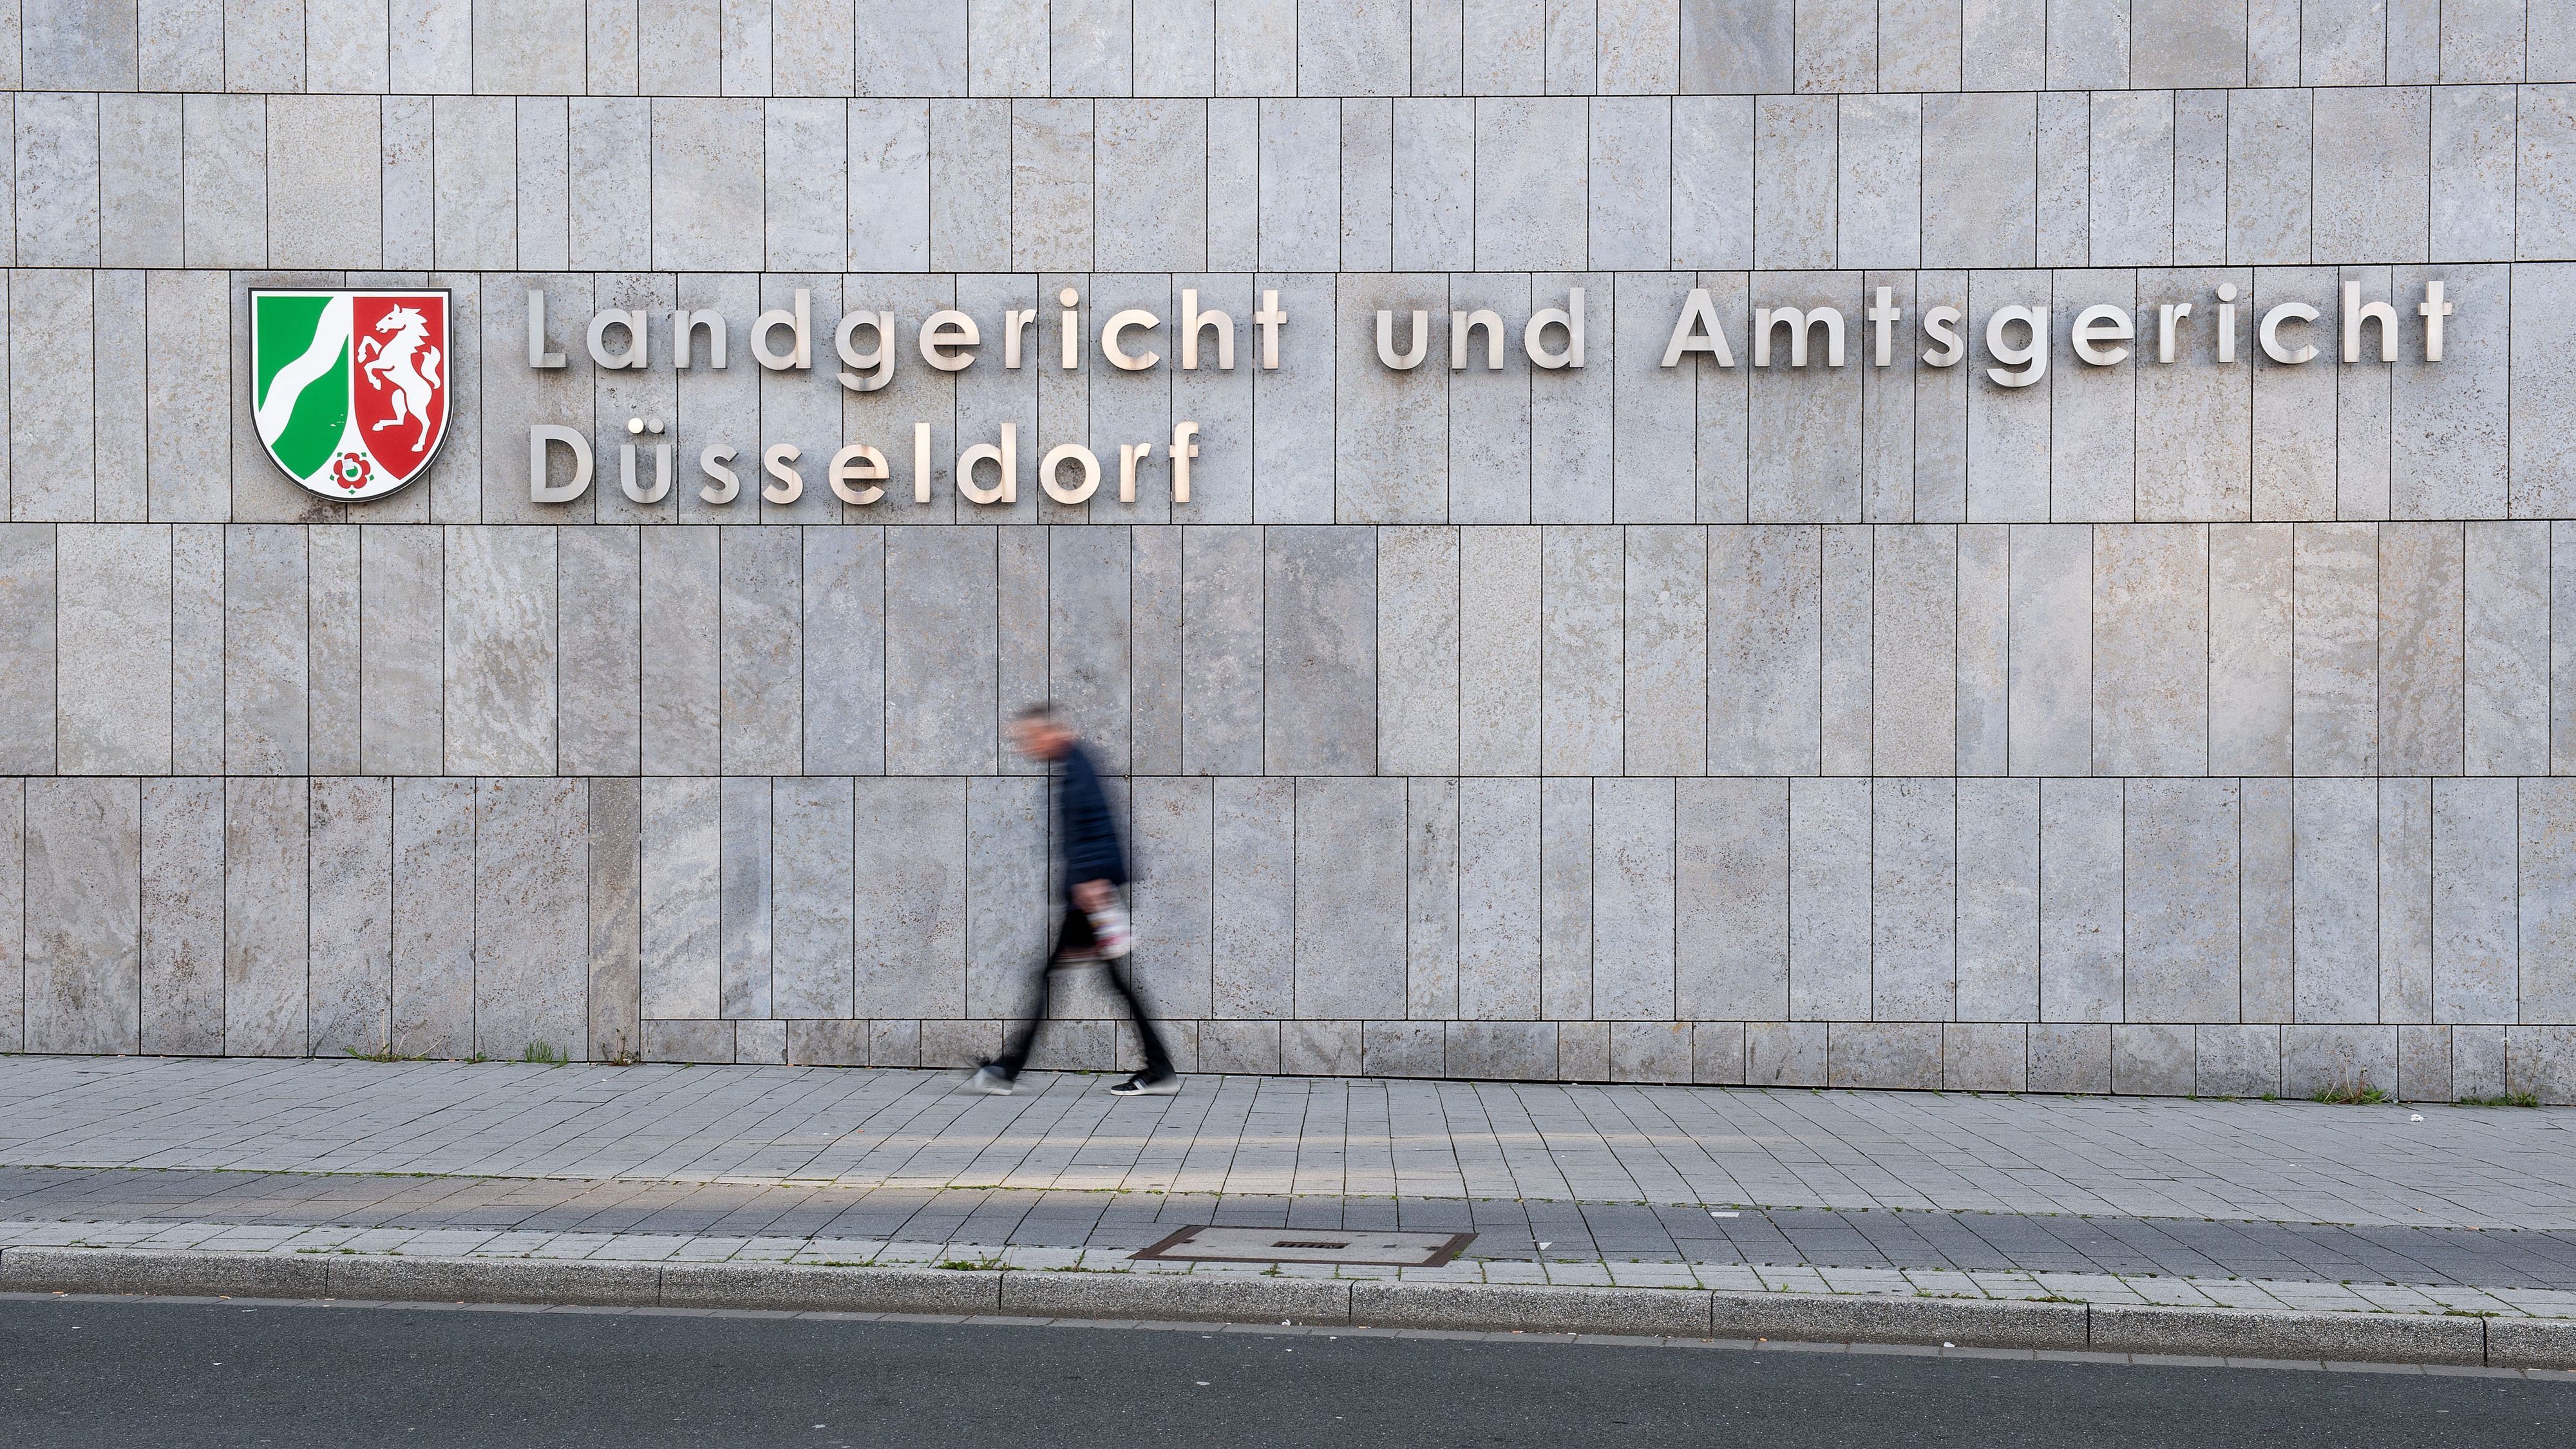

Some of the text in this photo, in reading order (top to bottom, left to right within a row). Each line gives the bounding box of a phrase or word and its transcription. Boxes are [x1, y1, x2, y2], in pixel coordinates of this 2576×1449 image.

[529, 280, 2452, 392] Landgericht und Amtsgericht
[530, 417, 1198, 505] Düsseldorf
